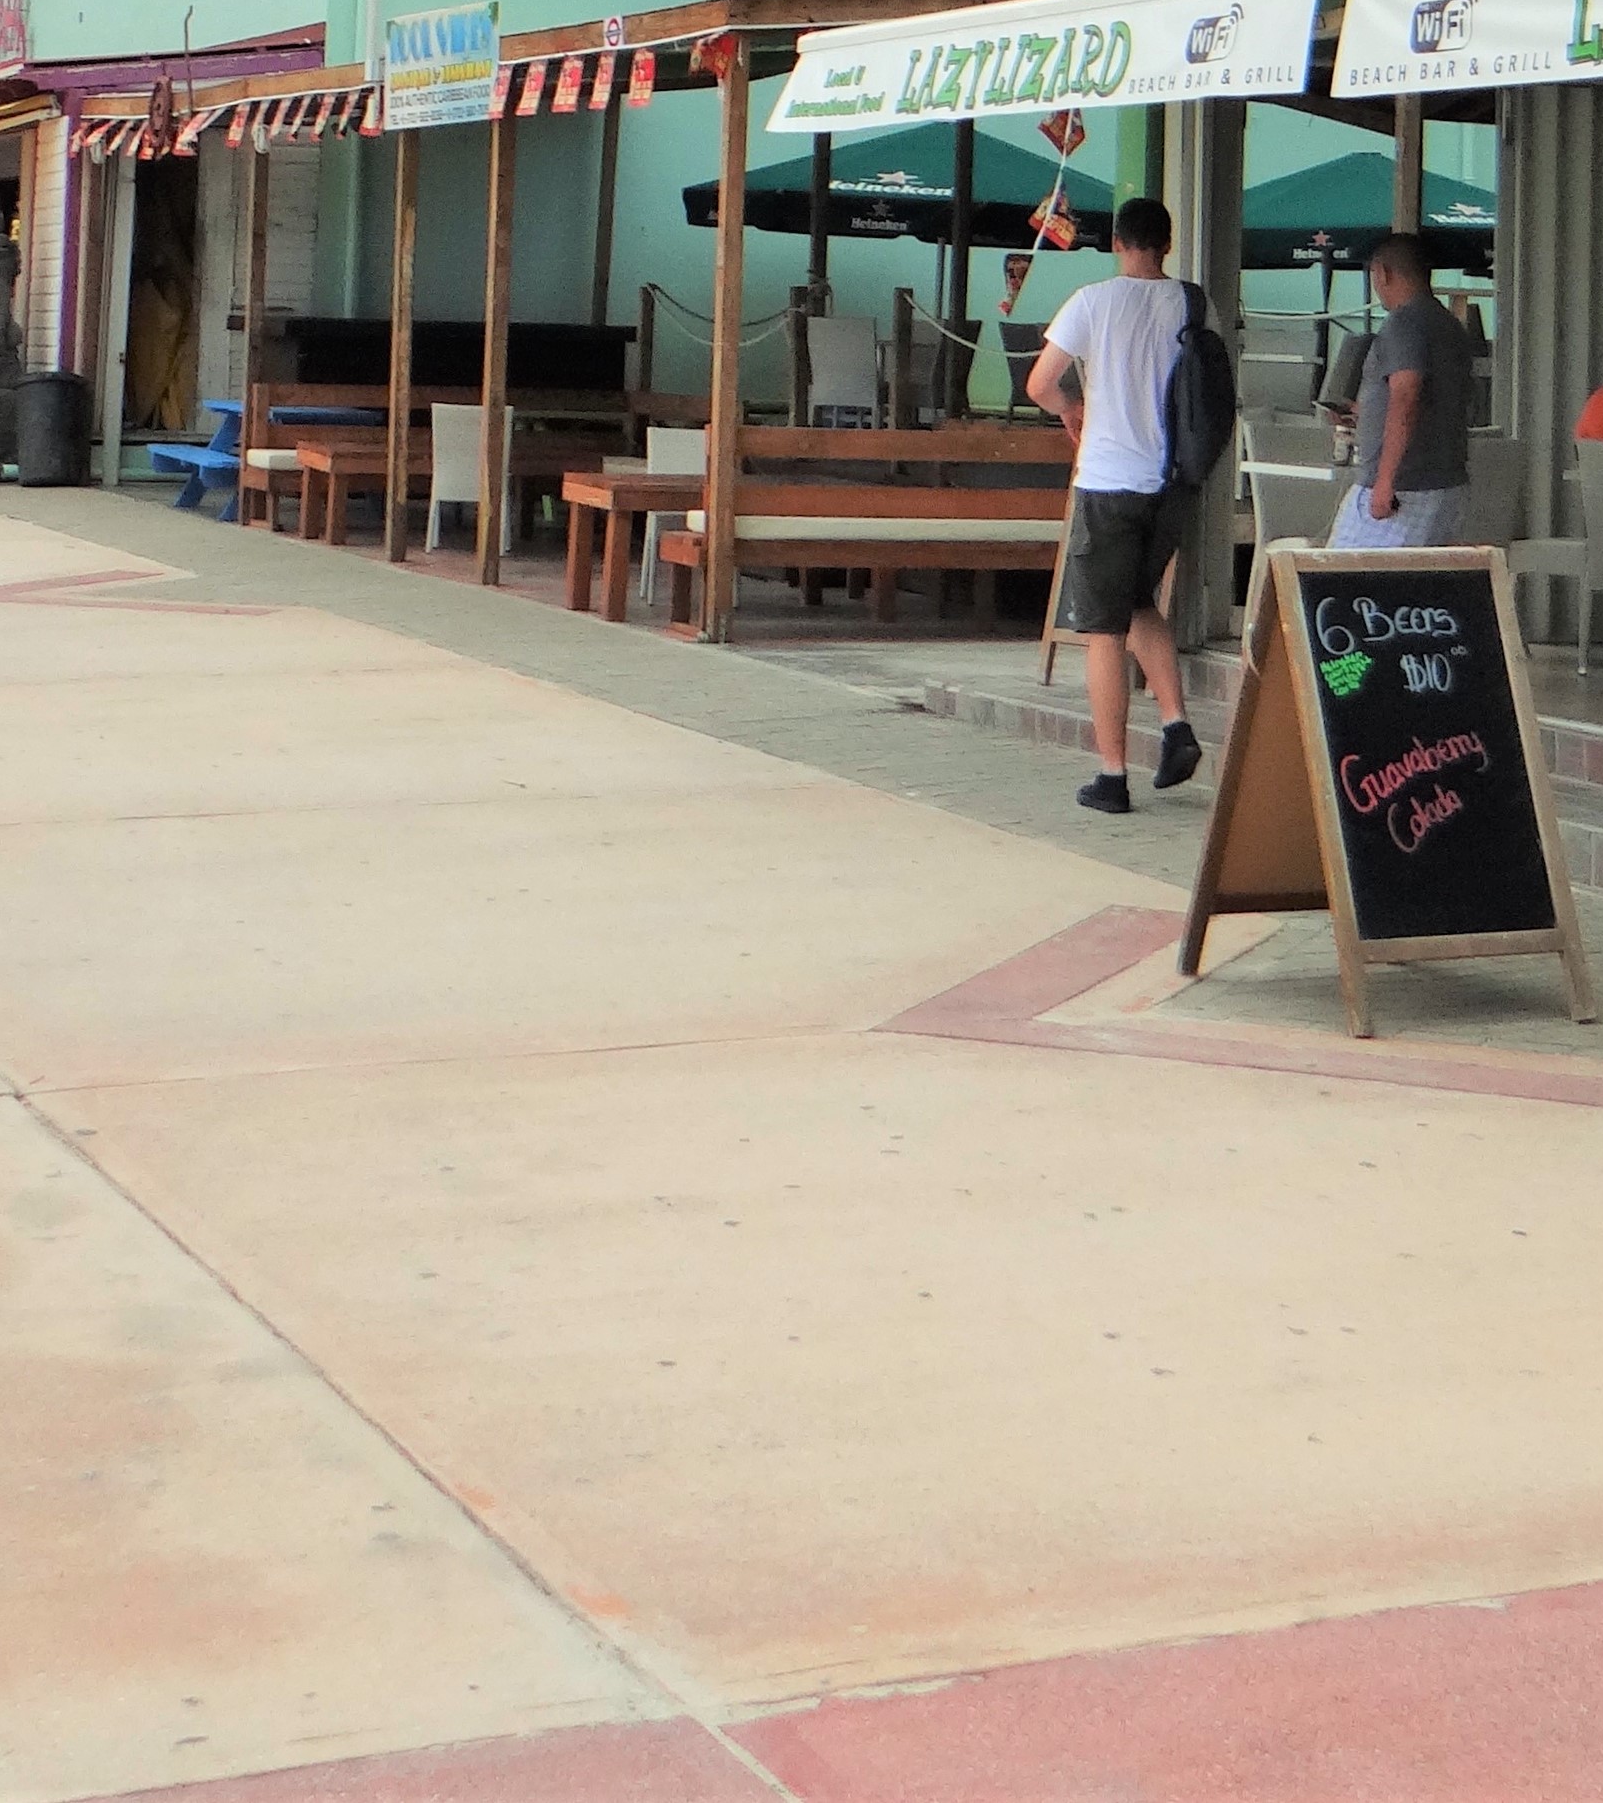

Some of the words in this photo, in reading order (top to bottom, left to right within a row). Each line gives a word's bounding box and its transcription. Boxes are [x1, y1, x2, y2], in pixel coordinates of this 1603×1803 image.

[1128, 73, 1176, 94] BEACH
[1185, 70, 1211, 89] BAR
[1221, 68, 1231, 86] &
[1245, 65, 1294, 84] GRILL
[1350, 64, 1407, 86] BEACH
[1420, 61, 1456, 80] BAR
[1469, 57, 1479, 76] &
[1494, 51, 1552, 73] GRILL
[851, 218, 908, 231] Heineken
[1315, 596, 1355, 655] 6
[1340, 731, 1489, 813] Guavaberry
[1387, 783, 1463, 853] Colada
